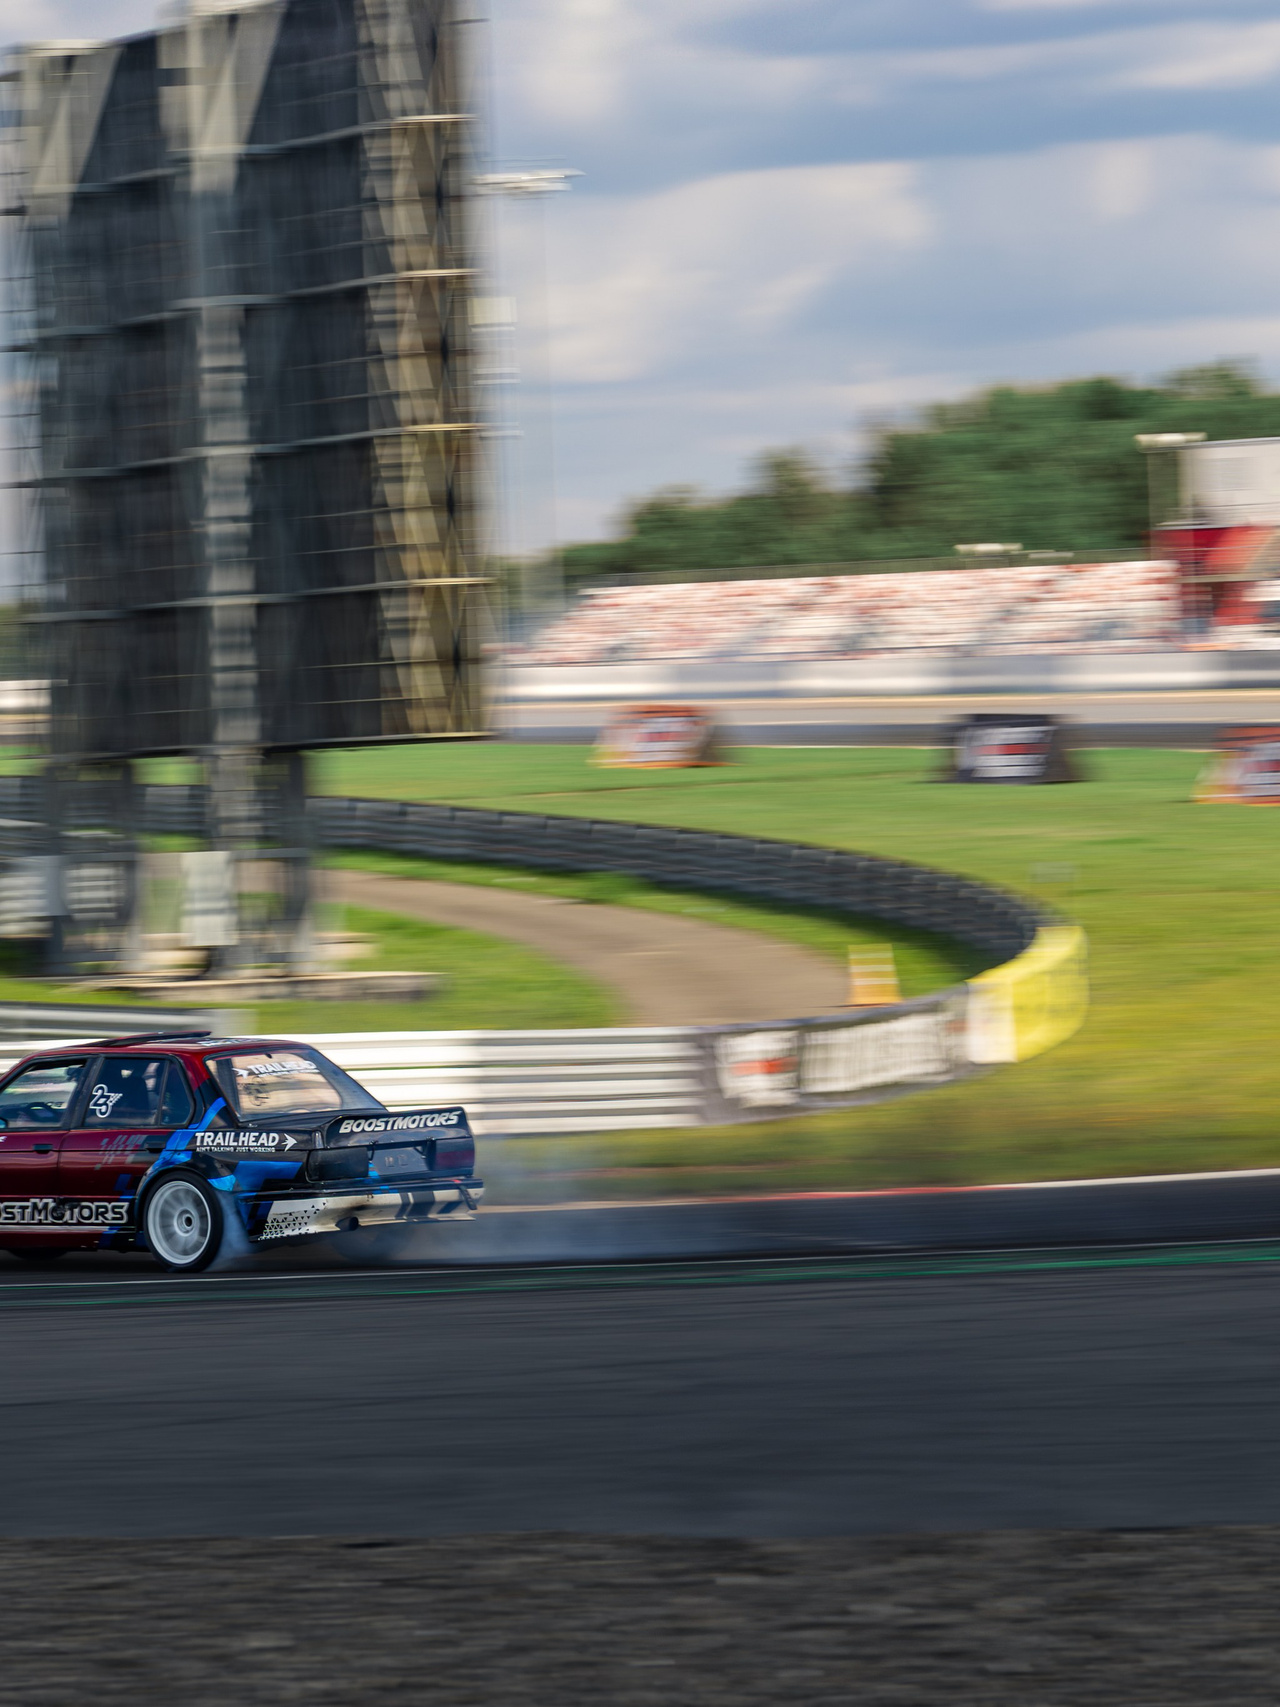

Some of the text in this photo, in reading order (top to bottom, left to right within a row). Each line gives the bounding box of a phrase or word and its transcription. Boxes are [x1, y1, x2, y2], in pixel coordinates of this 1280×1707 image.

[247, 1060, 317, 1075] TRAILHEAD
[339, 1110, 461, 1133] BOOSTMOTORS
[195, 1132, 279, 1146] TRAILHEAD
